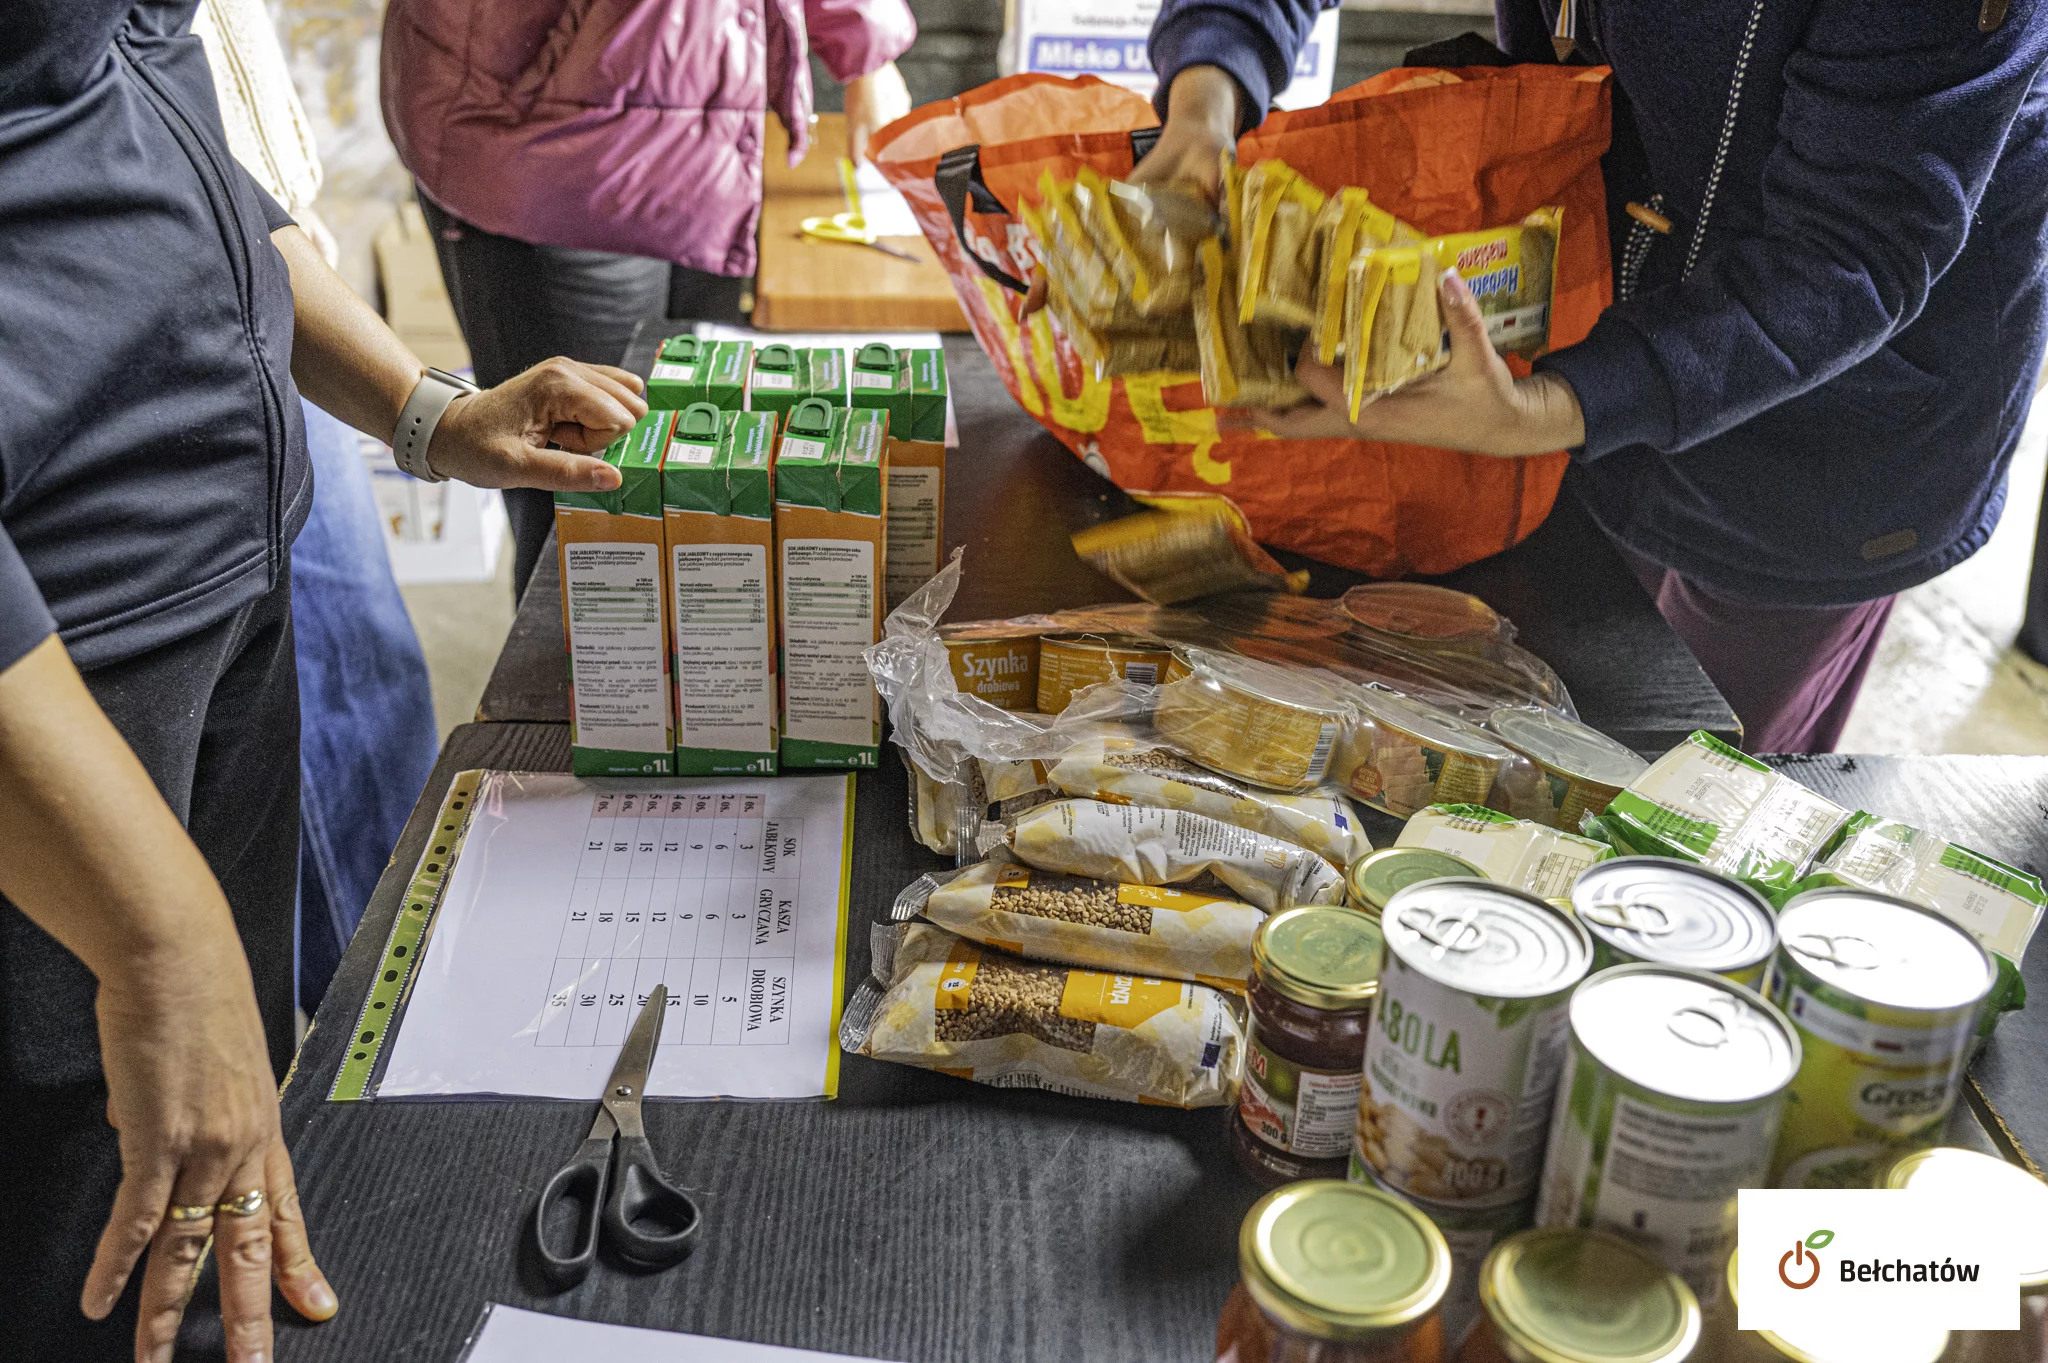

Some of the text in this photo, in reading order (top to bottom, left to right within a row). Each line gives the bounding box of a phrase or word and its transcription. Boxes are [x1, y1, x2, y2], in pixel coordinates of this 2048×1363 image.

[1036, 40, 1121, 69] Mleko
[962, 649, 1028, 682] Szynka
[858, 752, 874, 765] 1L
[653, 758, 670, 773] 1L
[756, 758, 774, 772] 1L
[598, 800, 608, 812] os.
[622, 800, 634, 812] os.
[646, 800, 658, 812] os.
[672, 802, 682, 812] os.
[696, 802, 706, 812] os.
[720, 802, 730, 812] os.
[744, 802, 754, 812] os.
[588, 841, 604, 851] 21
[614, 842, 628, 852] 18
[640, 842, 654, 852] 15
[664, 842, 678, 852] 12
[762, 822, 780, 874] JABŁKOWY
[782, 838, 796, 856] SOK
[572, 911, 588, 922] 21
[598, 912, 614, 923] 18
[626, 912, 640, 923] 15
[652, 912, 666, 923] 12
[756, 888, 774, 944] GRYCZANA
[776, 900, 792, 934] KASZA
[580, 994, 596, 1006] 30
[608, 994, 624, 1006] 25
[694, 994, 708, 1006] 10
[746, 970, 766, 1032] DROBIOWA
[770, 976, 786, 1022] SZYNKA
[1260, 1121, 1279, 1140] 300
